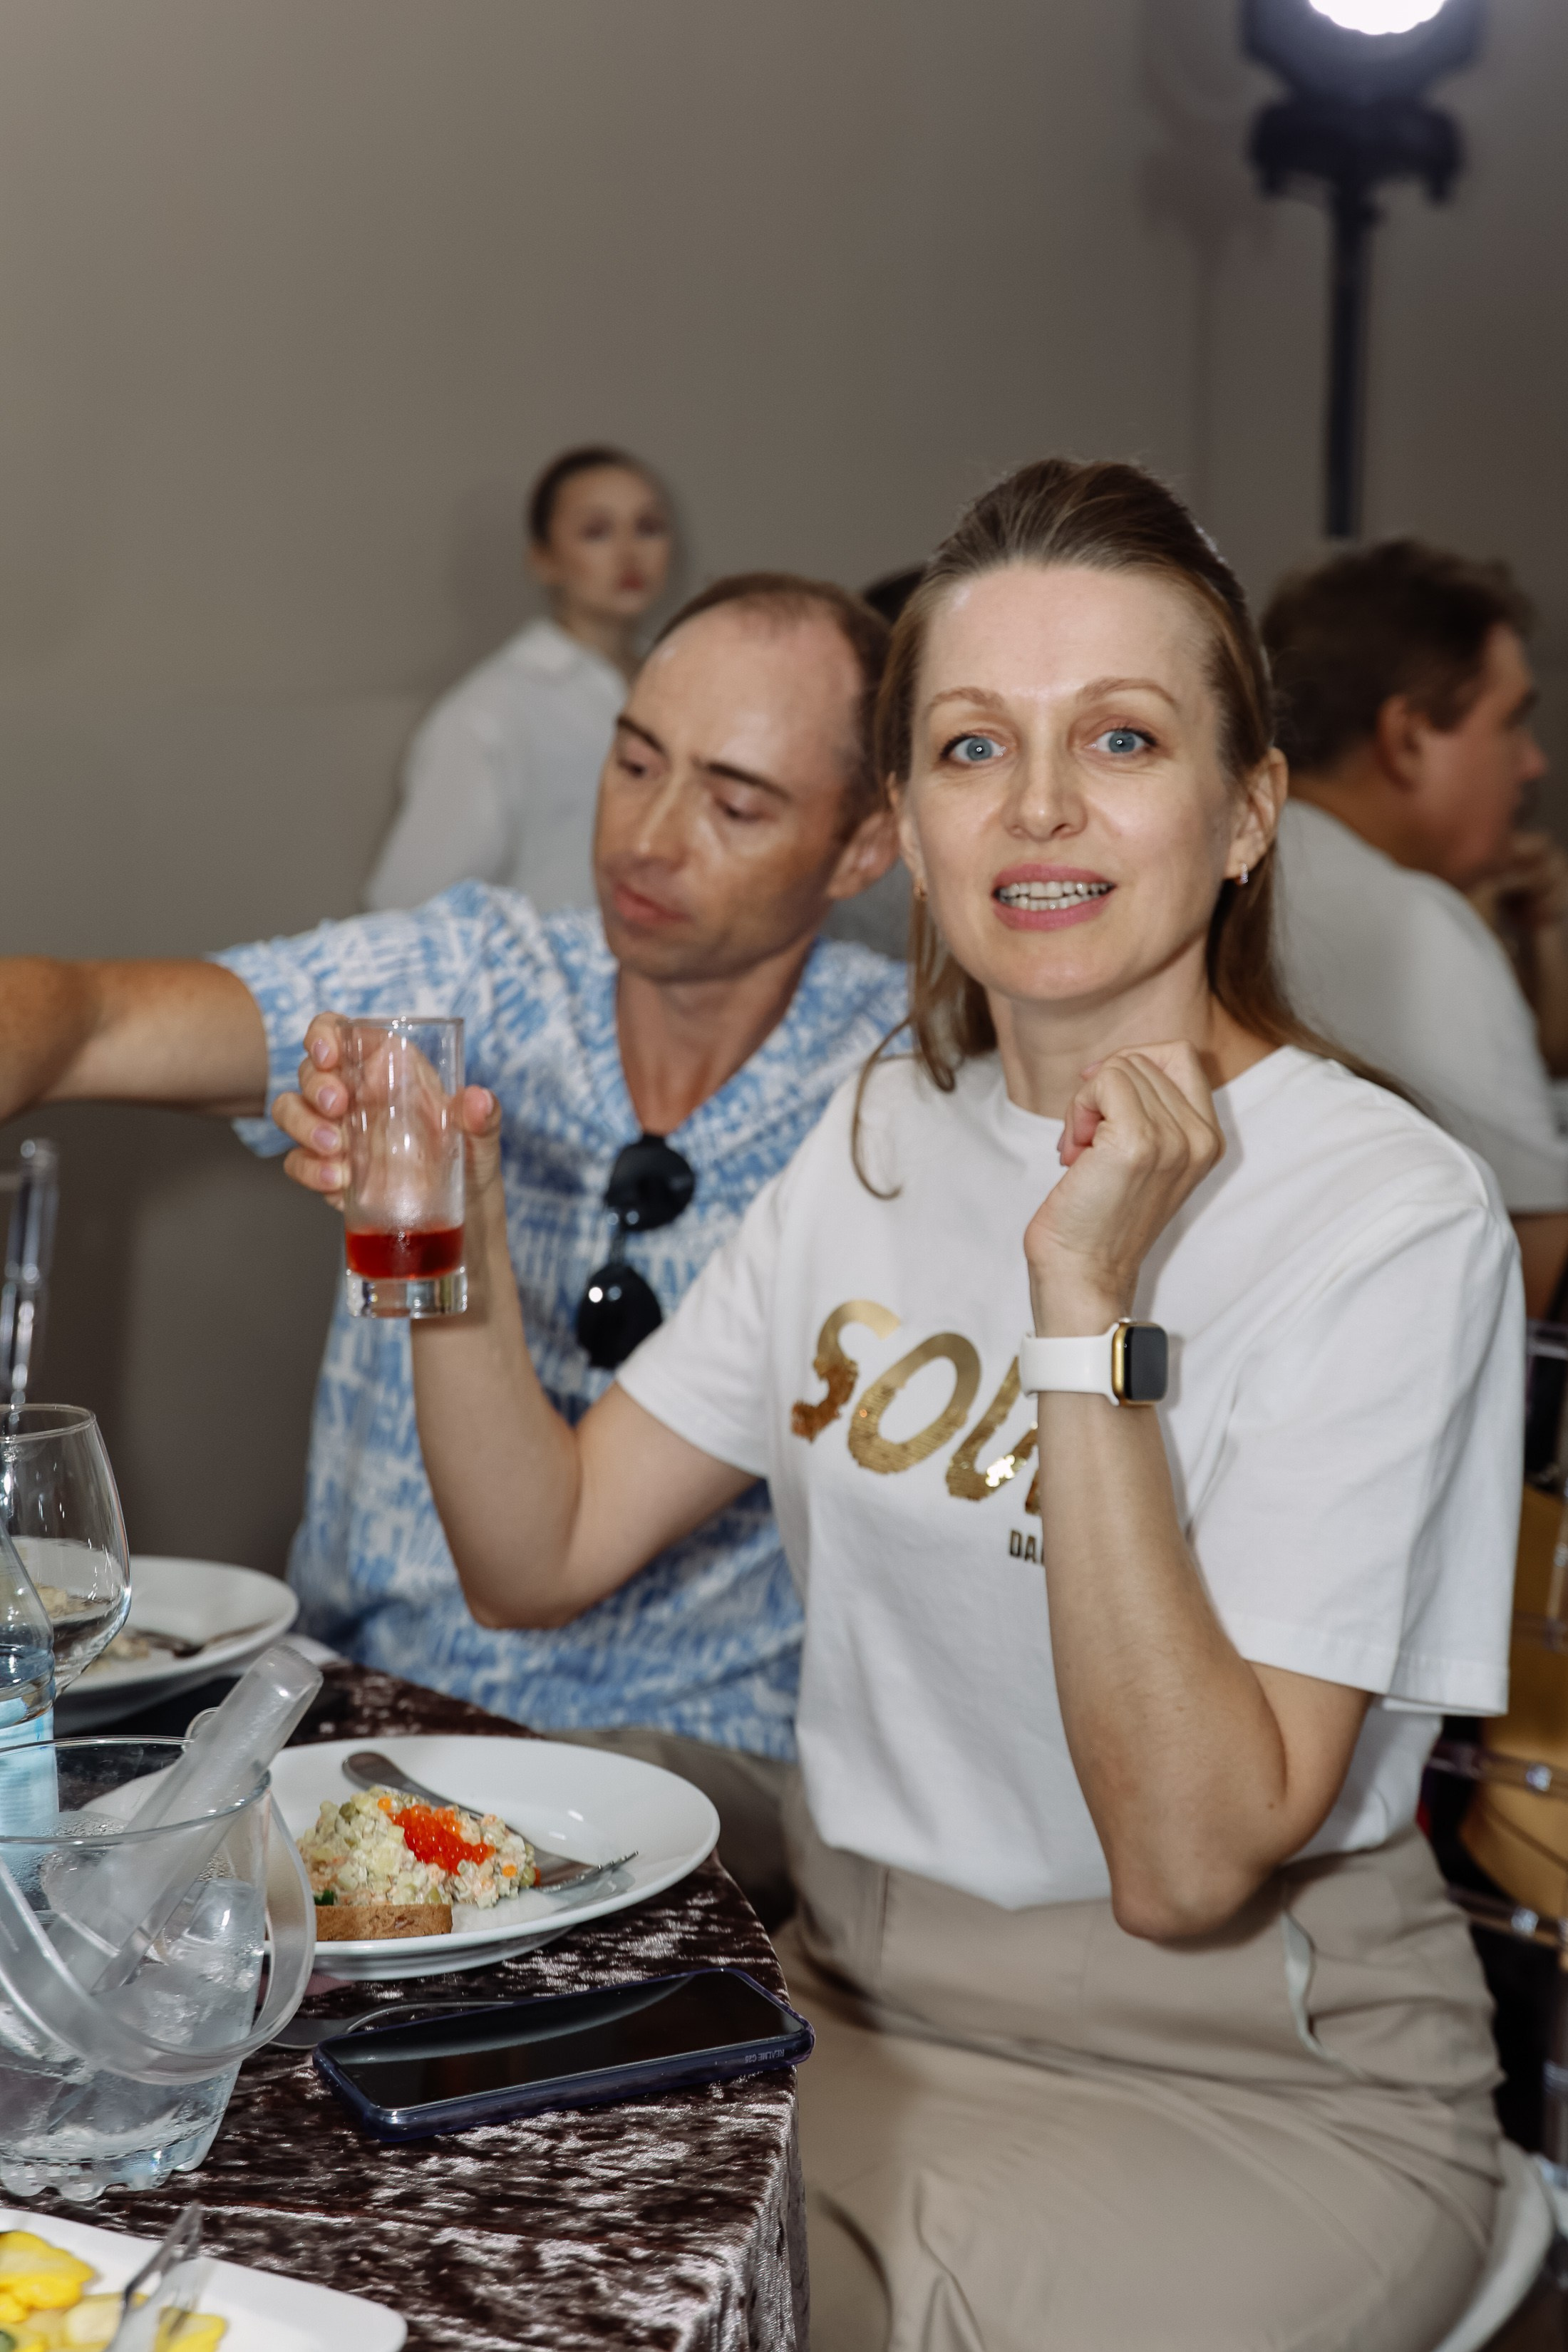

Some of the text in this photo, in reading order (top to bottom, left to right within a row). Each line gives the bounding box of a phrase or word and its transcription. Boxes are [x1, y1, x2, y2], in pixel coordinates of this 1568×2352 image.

[791, 1298, 1042, 1515] SOU
[1009, 1530, 1044, 1564] DA
[758, 2049, 785, 2061] REALME
